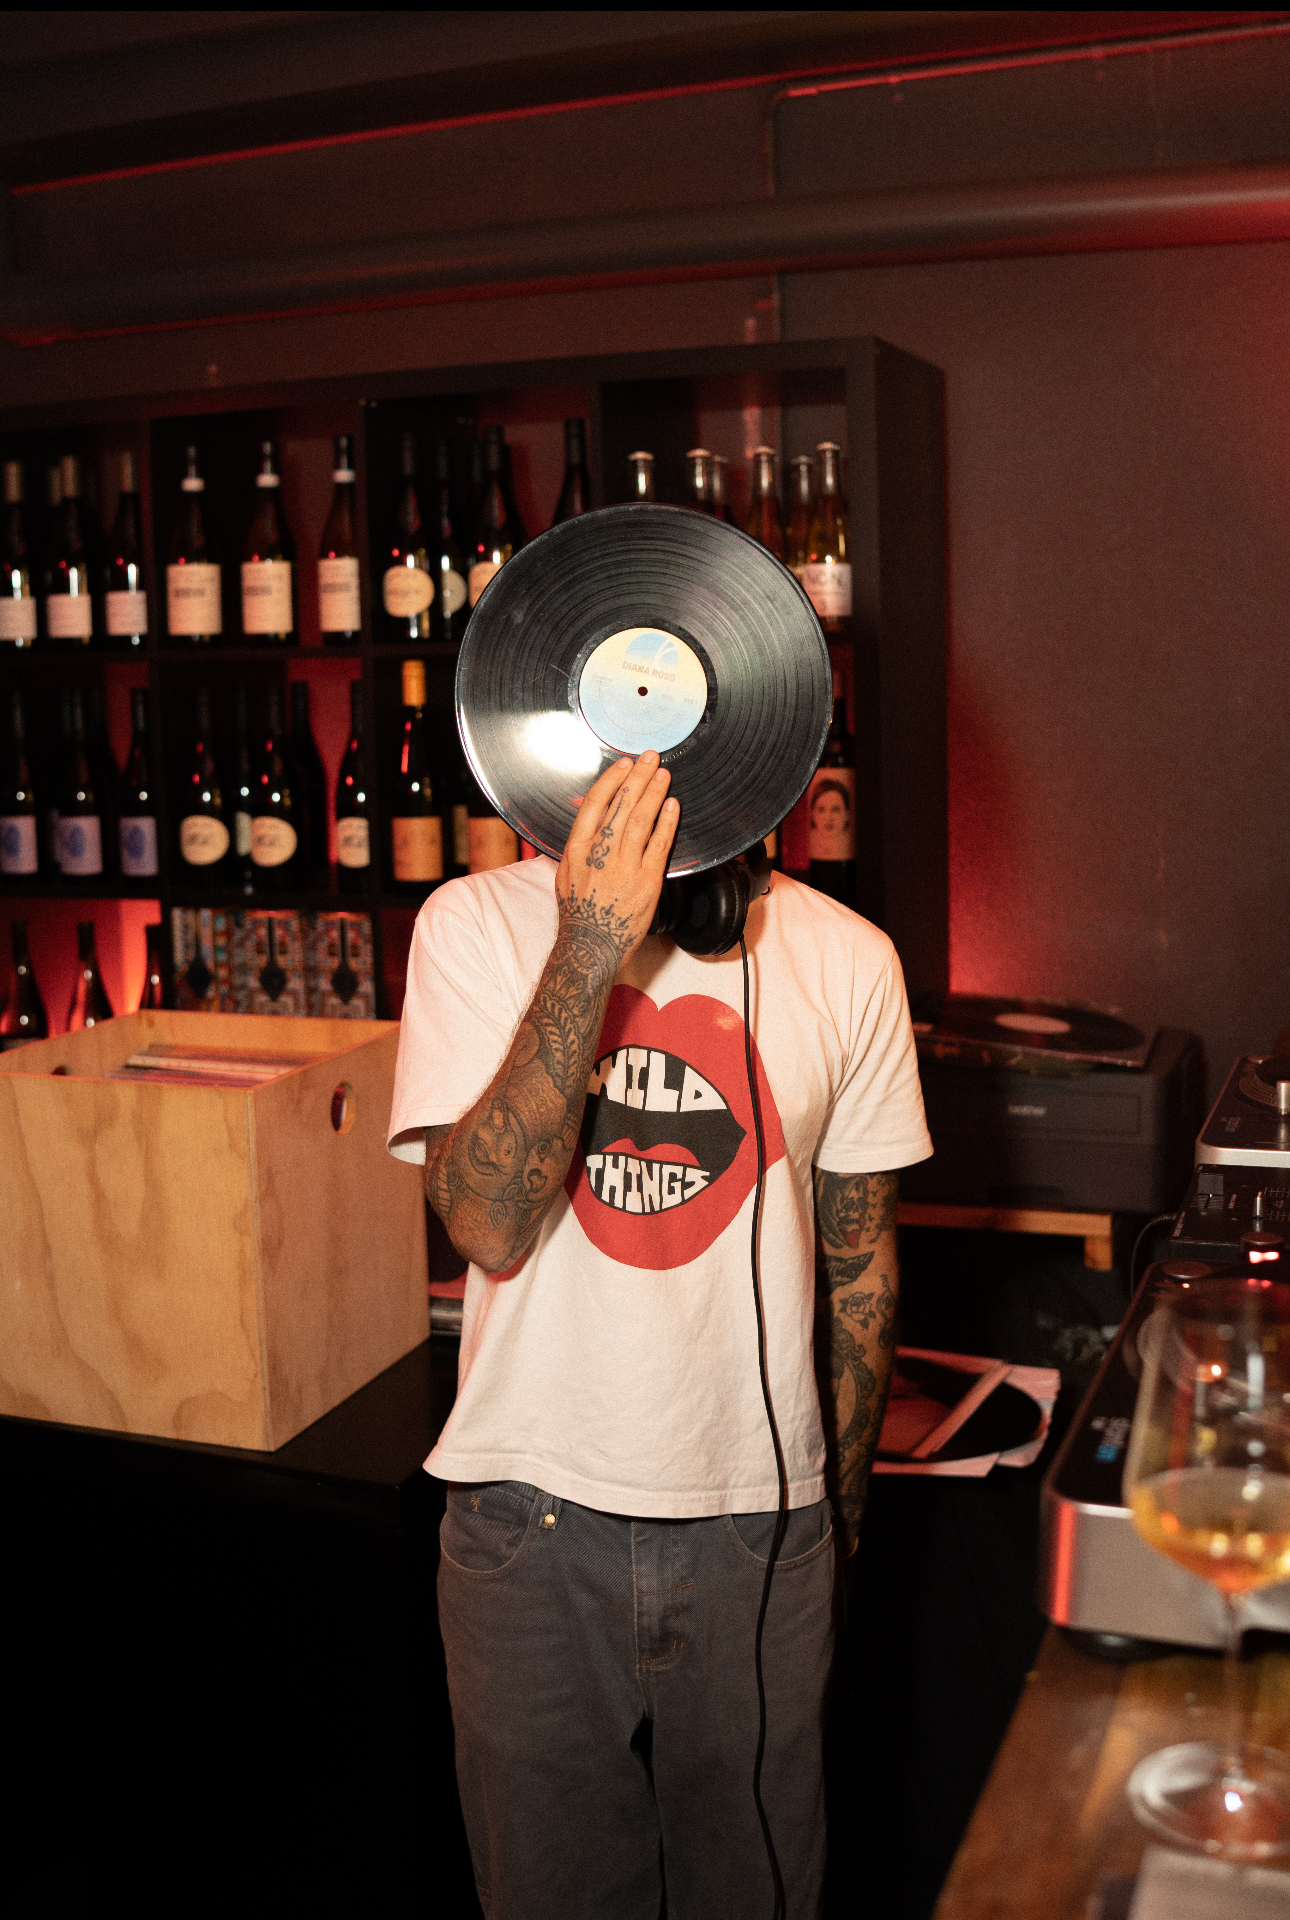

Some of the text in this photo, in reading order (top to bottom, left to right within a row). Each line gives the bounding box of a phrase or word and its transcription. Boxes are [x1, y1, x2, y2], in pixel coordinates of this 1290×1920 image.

[621, 660, 676, 682] DIANA ROSS
[587, 1046, 728, 1113] WILD
[585, 1153, 711, 1215] THINGS
